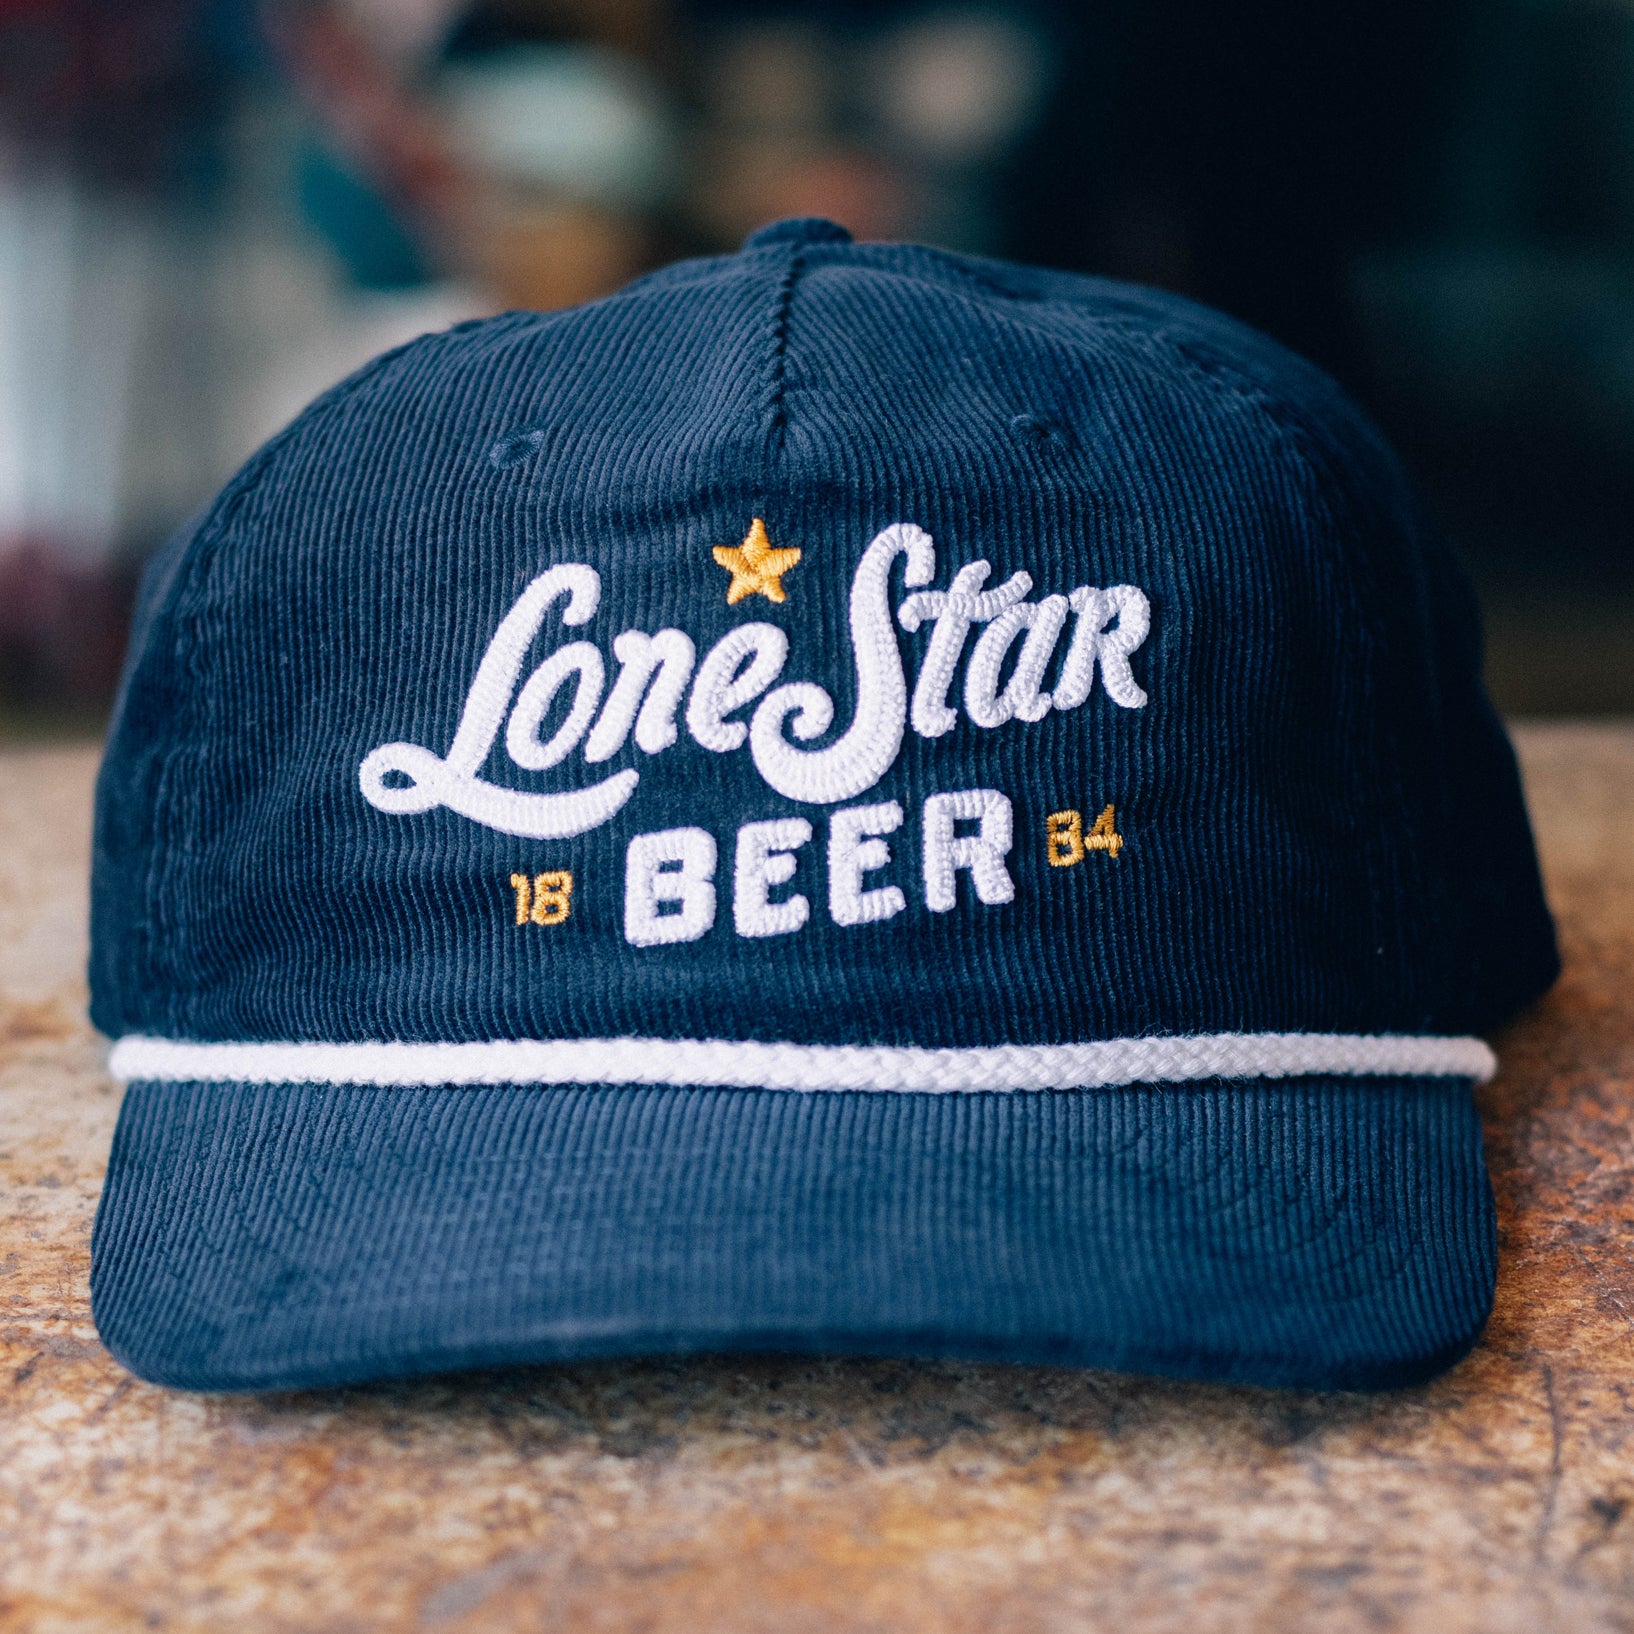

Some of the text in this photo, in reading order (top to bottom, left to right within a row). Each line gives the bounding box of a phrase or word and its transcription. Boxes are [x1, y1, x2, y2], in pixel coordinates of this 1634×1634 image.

[358, 562, 788, 840] Lone
[510, 788, 1125, 948] 18 BEER 84
